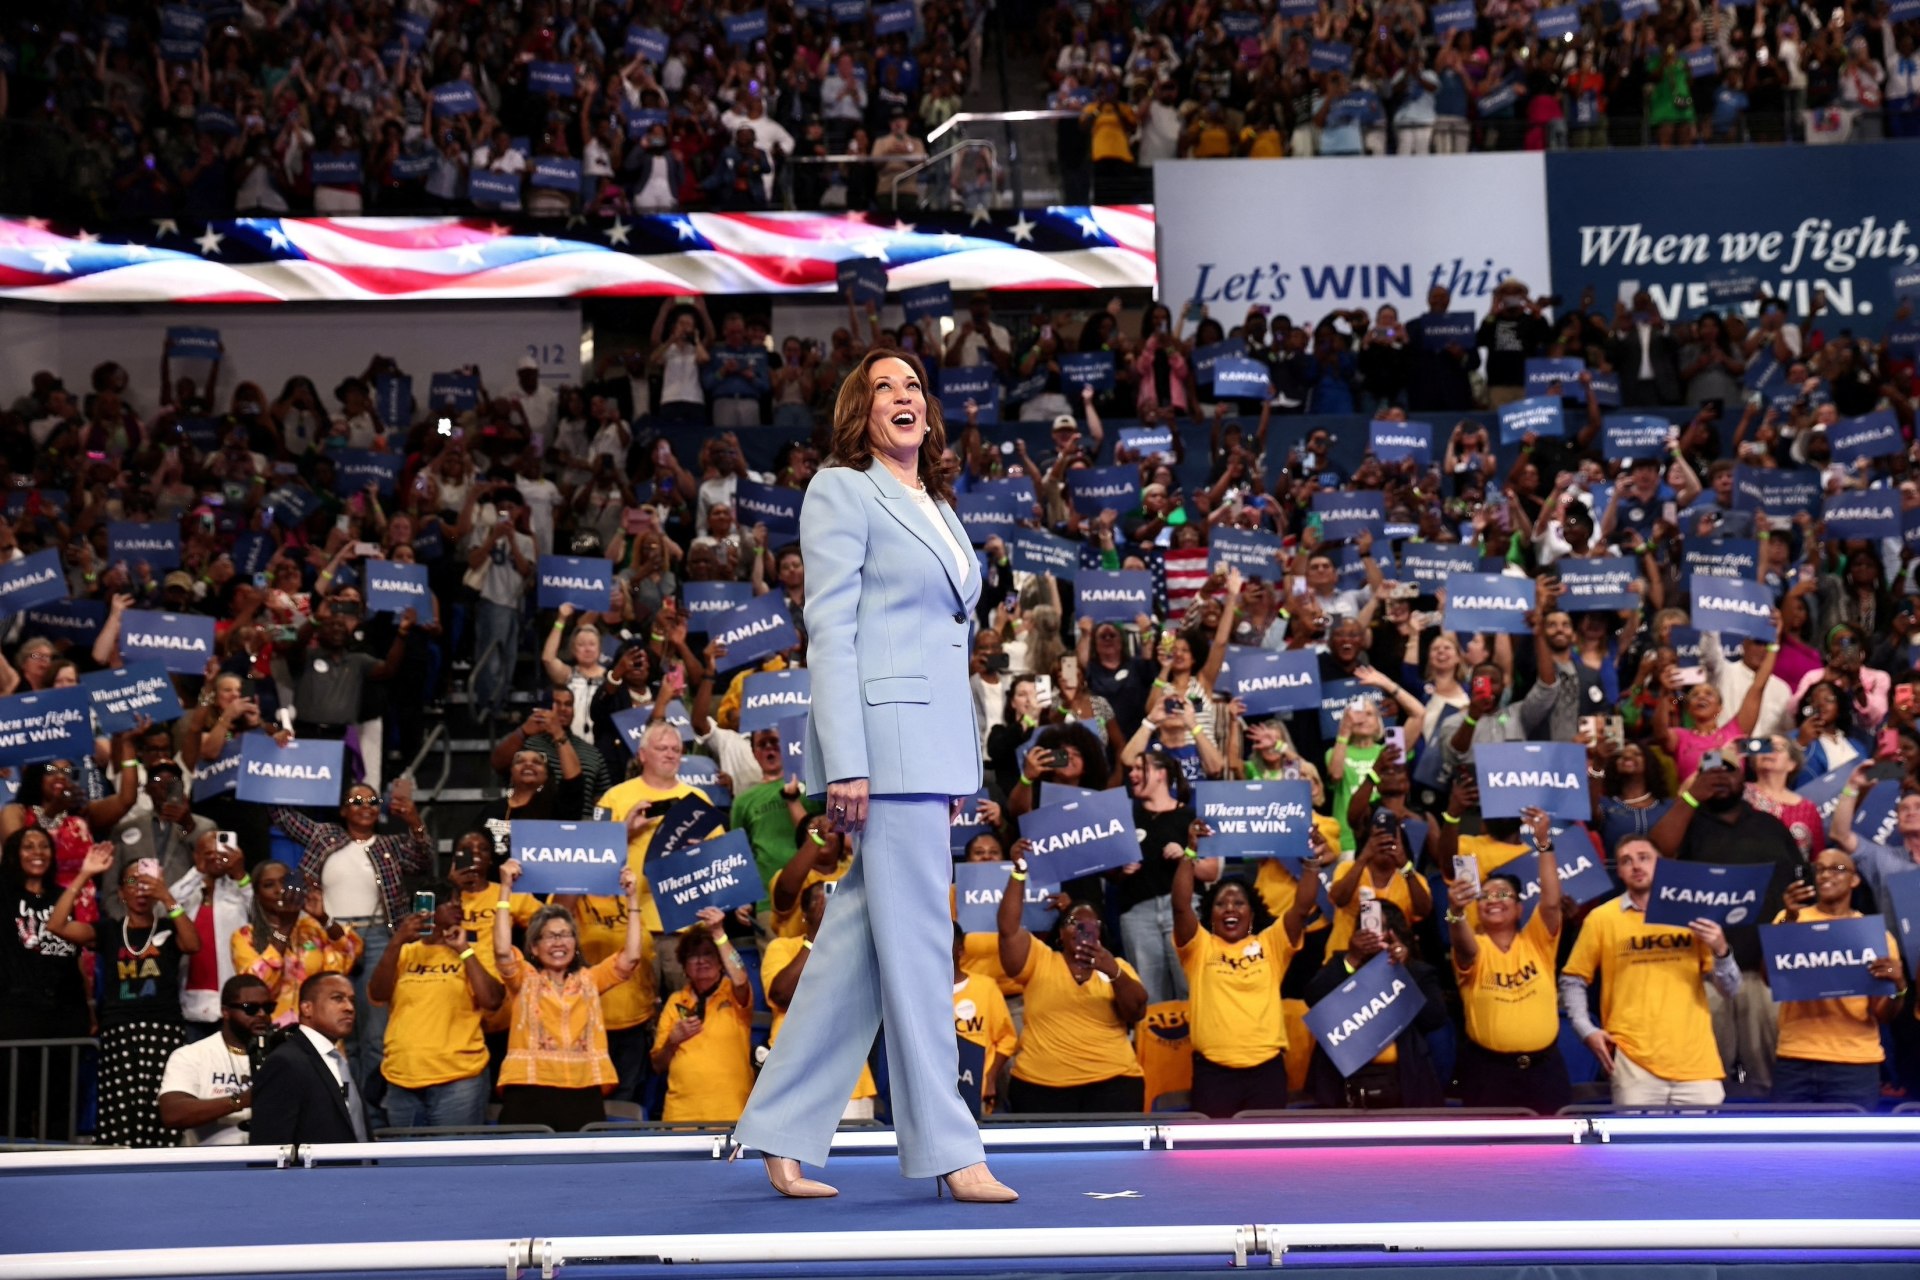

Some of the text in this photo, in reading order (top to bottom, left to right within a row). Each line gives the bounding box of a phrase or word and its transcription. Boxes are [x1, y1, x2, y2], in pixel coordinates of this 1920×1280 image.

[1579, 216, 1919, 275] When we fight,
[1192, 258, 1512, 303] Let's WIN this
[1074, 483, 1133, 497] KAMALA
[738, 498, 794, 518] KAMALA
[1320, 508, 1380, 521] KAMALA
[1825, 506, 1894, 521] KAMALA
[962, 511, 1014, 524] KAMALA
[114, 539, 175, 550] KAMALA
[0, 567, 56, 595] AMALA
[372, 578, 425, 594] KAMALA
[543, 575, 604, 591] KAMALA
[1082, 589, 1147, 602] KAMALA
[1453, 596, 1528, 610] KAMALA
[1698, 595, 1771, 616] KAMALA
[715, 613, 784, 646] KAMALA
[127, 633, 207, 652] KAMALA
[1238, 671, 1312, 693] KAMALA
[93, 686, 122, 702] When
[121, 684, 137, 697] we
[106, 701, 130, 714] WE
[24, 716, 44, 727] we
[29, 727, 71, 742] WIN.
[248, 760, 332, 780] KAMALA
[1488, 771, 1580, 790] KAMALA
[951, 811, 987, 826] ALA
[1204, 801, 1306, 820] When we fight,
[1218, 820, 1291, 834] WE WIN.
[1032, 819, 1125, 856] KAMALA
[522, 847, 617, 863] KAMALA
[658, 853, 748, 895] When we fight,
[673, 874, 739, 905] WE WIN.
[965, 888, 1050, 904] KAMLA
[1660, 885, 1756, 905] KAMALA
[1630, 933, 1692, 951] UFCW
[1775, 948, 1877, 970] KAMALA
[117, 958, 161, 980] MA
[1327, 978, 1406, 1047] KAMALA
[955, 1015, 984, 1033] CW
